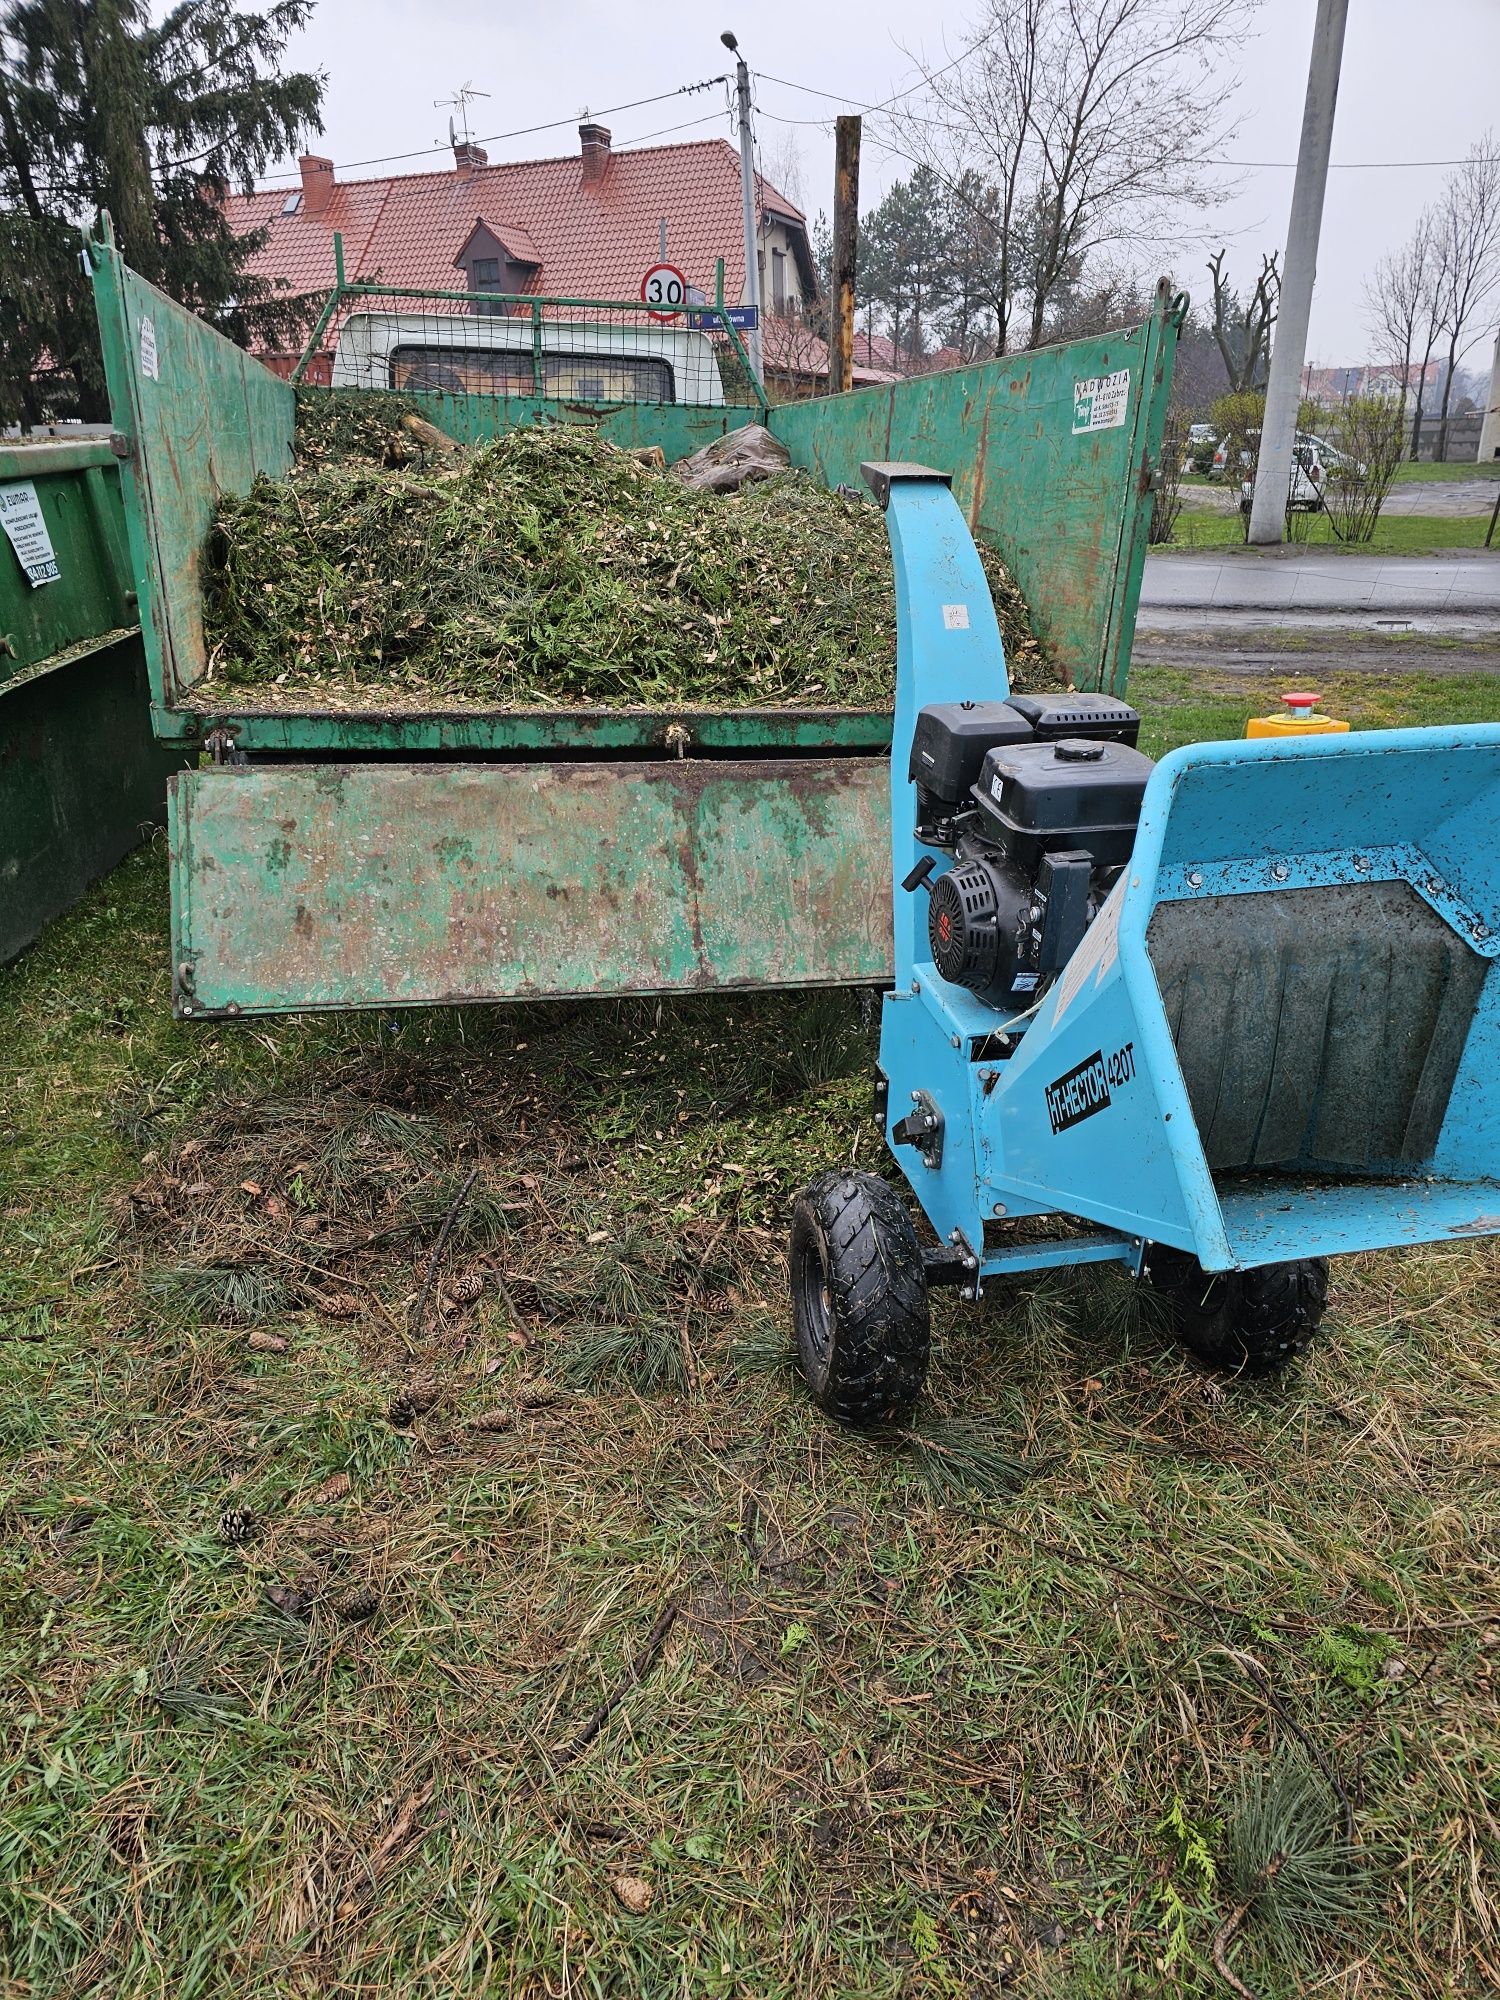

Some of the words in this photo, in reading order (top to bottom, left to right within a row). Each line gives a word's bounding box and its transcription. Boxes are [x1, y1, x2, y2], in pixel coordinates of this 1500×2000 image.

[648, 278, 682, 304] 30
[712, 315, 722, 324] ul.
[1076, 372, 1128, 395] NADWOZIA
[1048, 1060, 1108, 1126] HT-HECTOR
[1108, 1042, 1136, 1088] 420T
